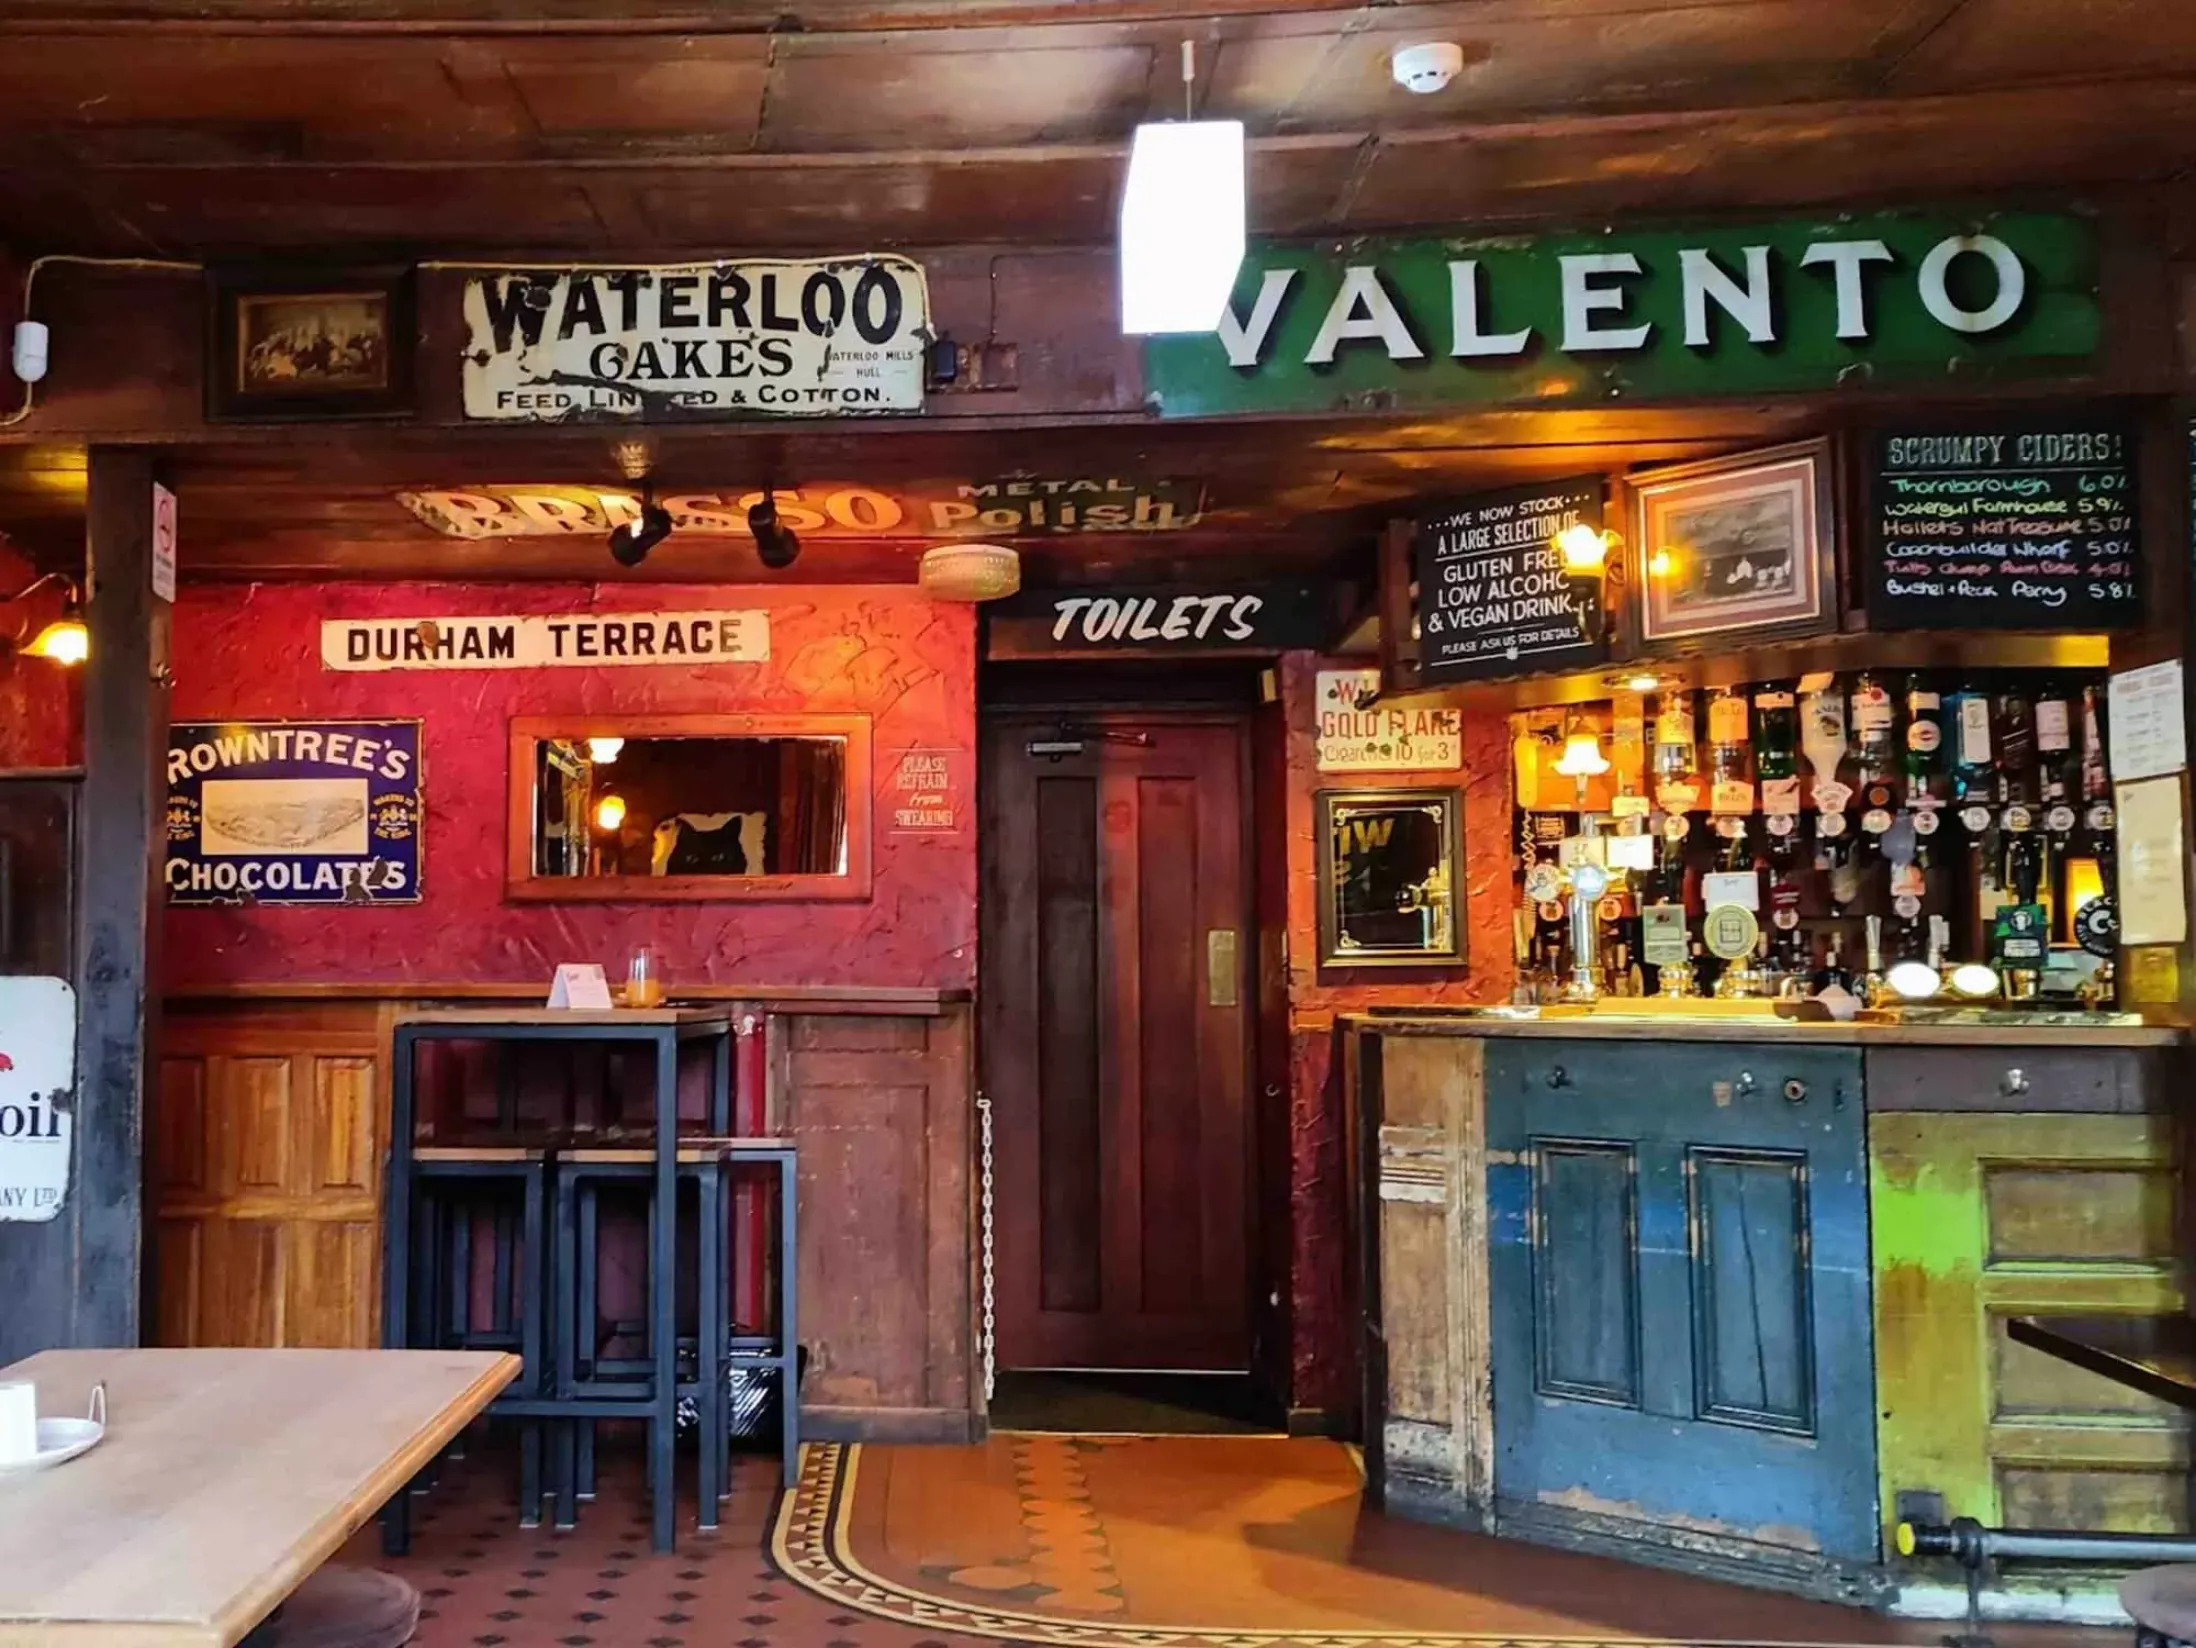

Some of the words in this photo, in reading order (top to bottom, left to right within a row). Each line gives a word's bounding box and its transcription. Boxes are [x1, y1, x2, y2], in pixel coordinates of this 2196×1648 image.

[484, 265, 903, 353] WATERLOO
[1216, 235, 2025, 366] VALENTO
[590, 335, 793, 380] CAKES
[828, 351, 879, 361] ATERLOO
[885, 351, 914, 361] MILLS
[856, 368, 880, 378] HULL
[496, 390, 572, 409] FEED
[590, 388, 718, 407] LINED
[731, 389, 747, 404] &
[758, 384, 890, 404] COTTON.
[1890, 435, 2006, 465] SCRUMPY
[2018, 432, 2122, 463] CIDERS!
[957, 478, 1136, 498] METAL
[1888, 478, 2051, 496] Thornborough
[929, 494, 1176, 530] Polish
[1479, 504, 1514, 522] NOW
[1971, 497, 2069, 514] Farmhouse
[1438, 534, 1447, 556] A
[1451, 526, 1491, 554] LARGE
[1494, 514, 1561, 546] SELECTION
[1444, 556, 1514, 584] GLUTEN
[1438, 583, 1482, 609] LOW
[2011, 580, 2068, 607] Perry
[1051, 594, 1264, 642] TOILETS
[1427, 611, 1445, 634] &
[1447, 603, 1510, 629] VEGAN
[1513, 592, 1577, 621] DRINK
[347, 624, 515, 662] DURHAM
[548, 618, 743, 658] TERRACE
[1442, 641, 1478, 655] PLEASE
[1480, 638, 1502, 650] ASK
[1502, 635, 1517, 647] US
[1518, 631, 1538, 645] FOR
[1540, 627, 1580, 642] DETAILS
[1322, 710, 1379, 739] GOLD
[167, 730, 411, 785] ROWNTREE'S
[165, 857, 407, 891] CHOCOLATES
